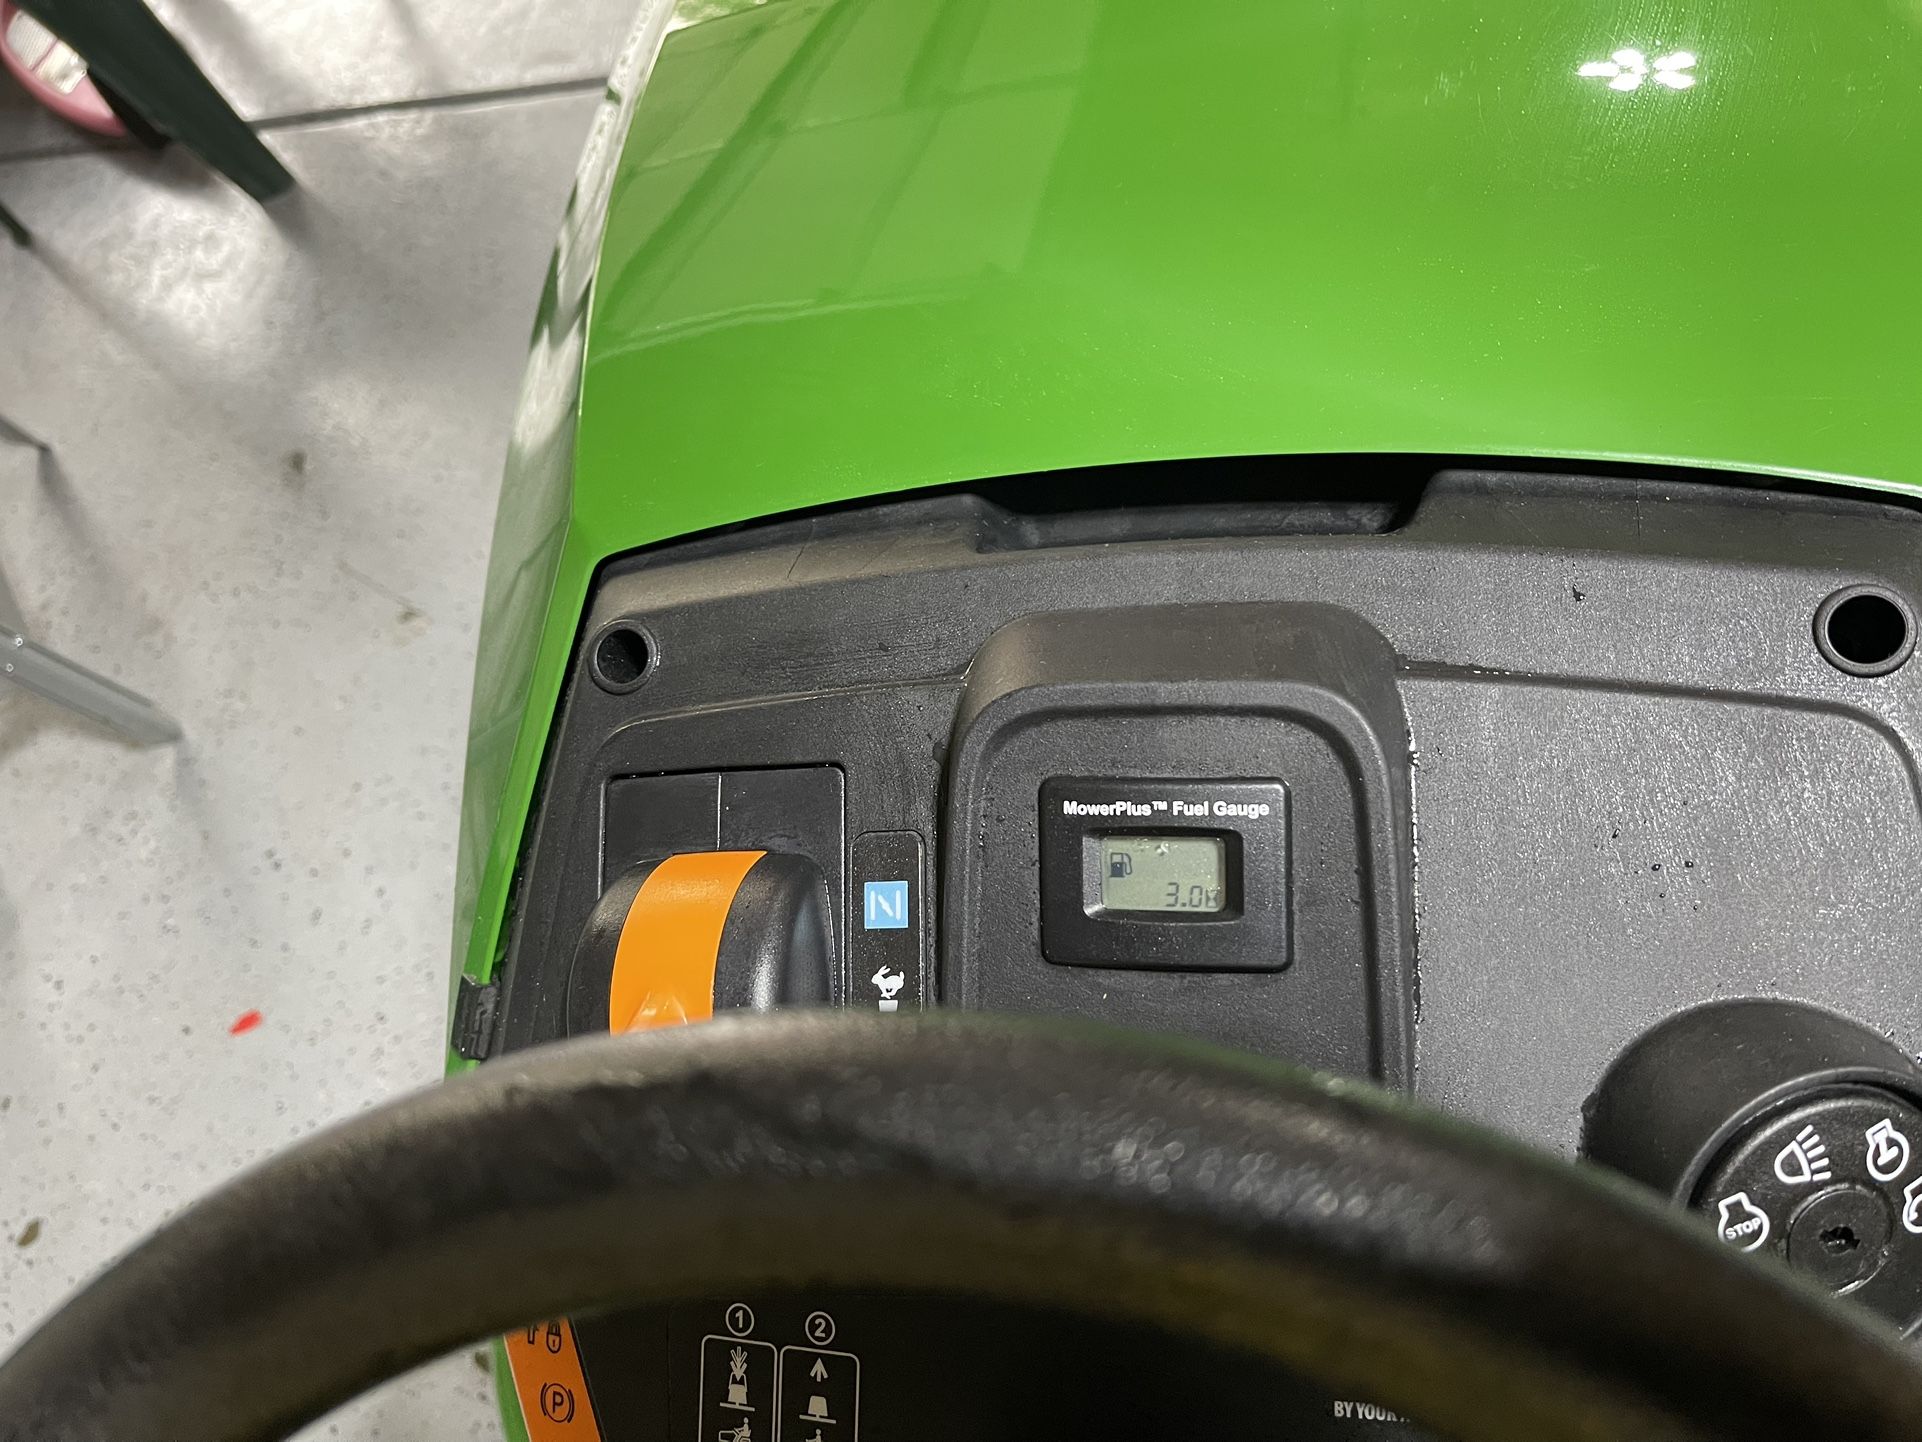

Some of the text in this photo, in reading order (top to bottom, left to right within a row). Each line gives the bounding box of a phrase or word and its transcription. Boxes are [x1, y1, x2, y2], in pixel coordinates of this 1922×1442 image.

[1172, 801, 1209, 816] Fuel
[1213, 801, 1270, 818] Gauge
[1725, 1217, 1762, 1240] STOP
[1334, 1400, 1354, 1418] BY
